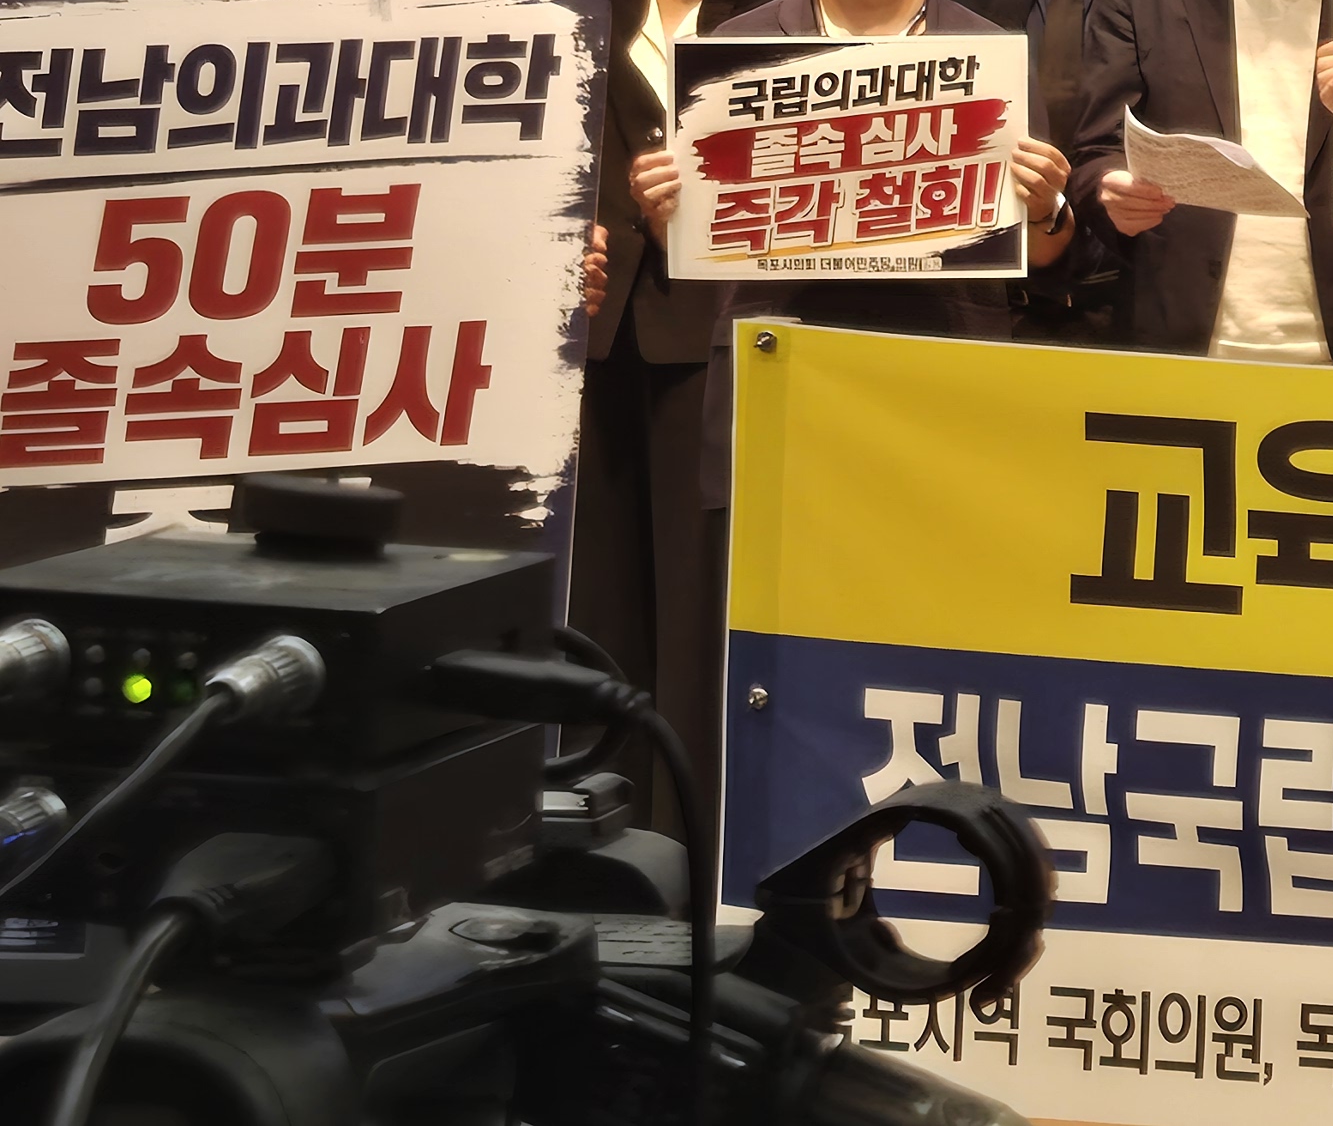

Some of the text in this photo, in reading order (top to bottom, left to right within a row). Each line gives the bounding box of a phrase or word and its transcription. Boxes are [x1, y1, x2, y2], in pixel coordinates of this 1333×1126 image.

[0, 33, 562, 158] 전남의과대학
[728, 55, 980, 121] 국립의과대학
[751, 116, 958, 179] 졸속 심사
[86, 183, 421, 326] 50분
[709, 163, 1000, 251] 즉각 철회!
[0, 320, 492, 467] 졸속심사
[838, 976, 1021, 1066] 포지역
[1046, 985, 1273, 1087] 국회의원,
